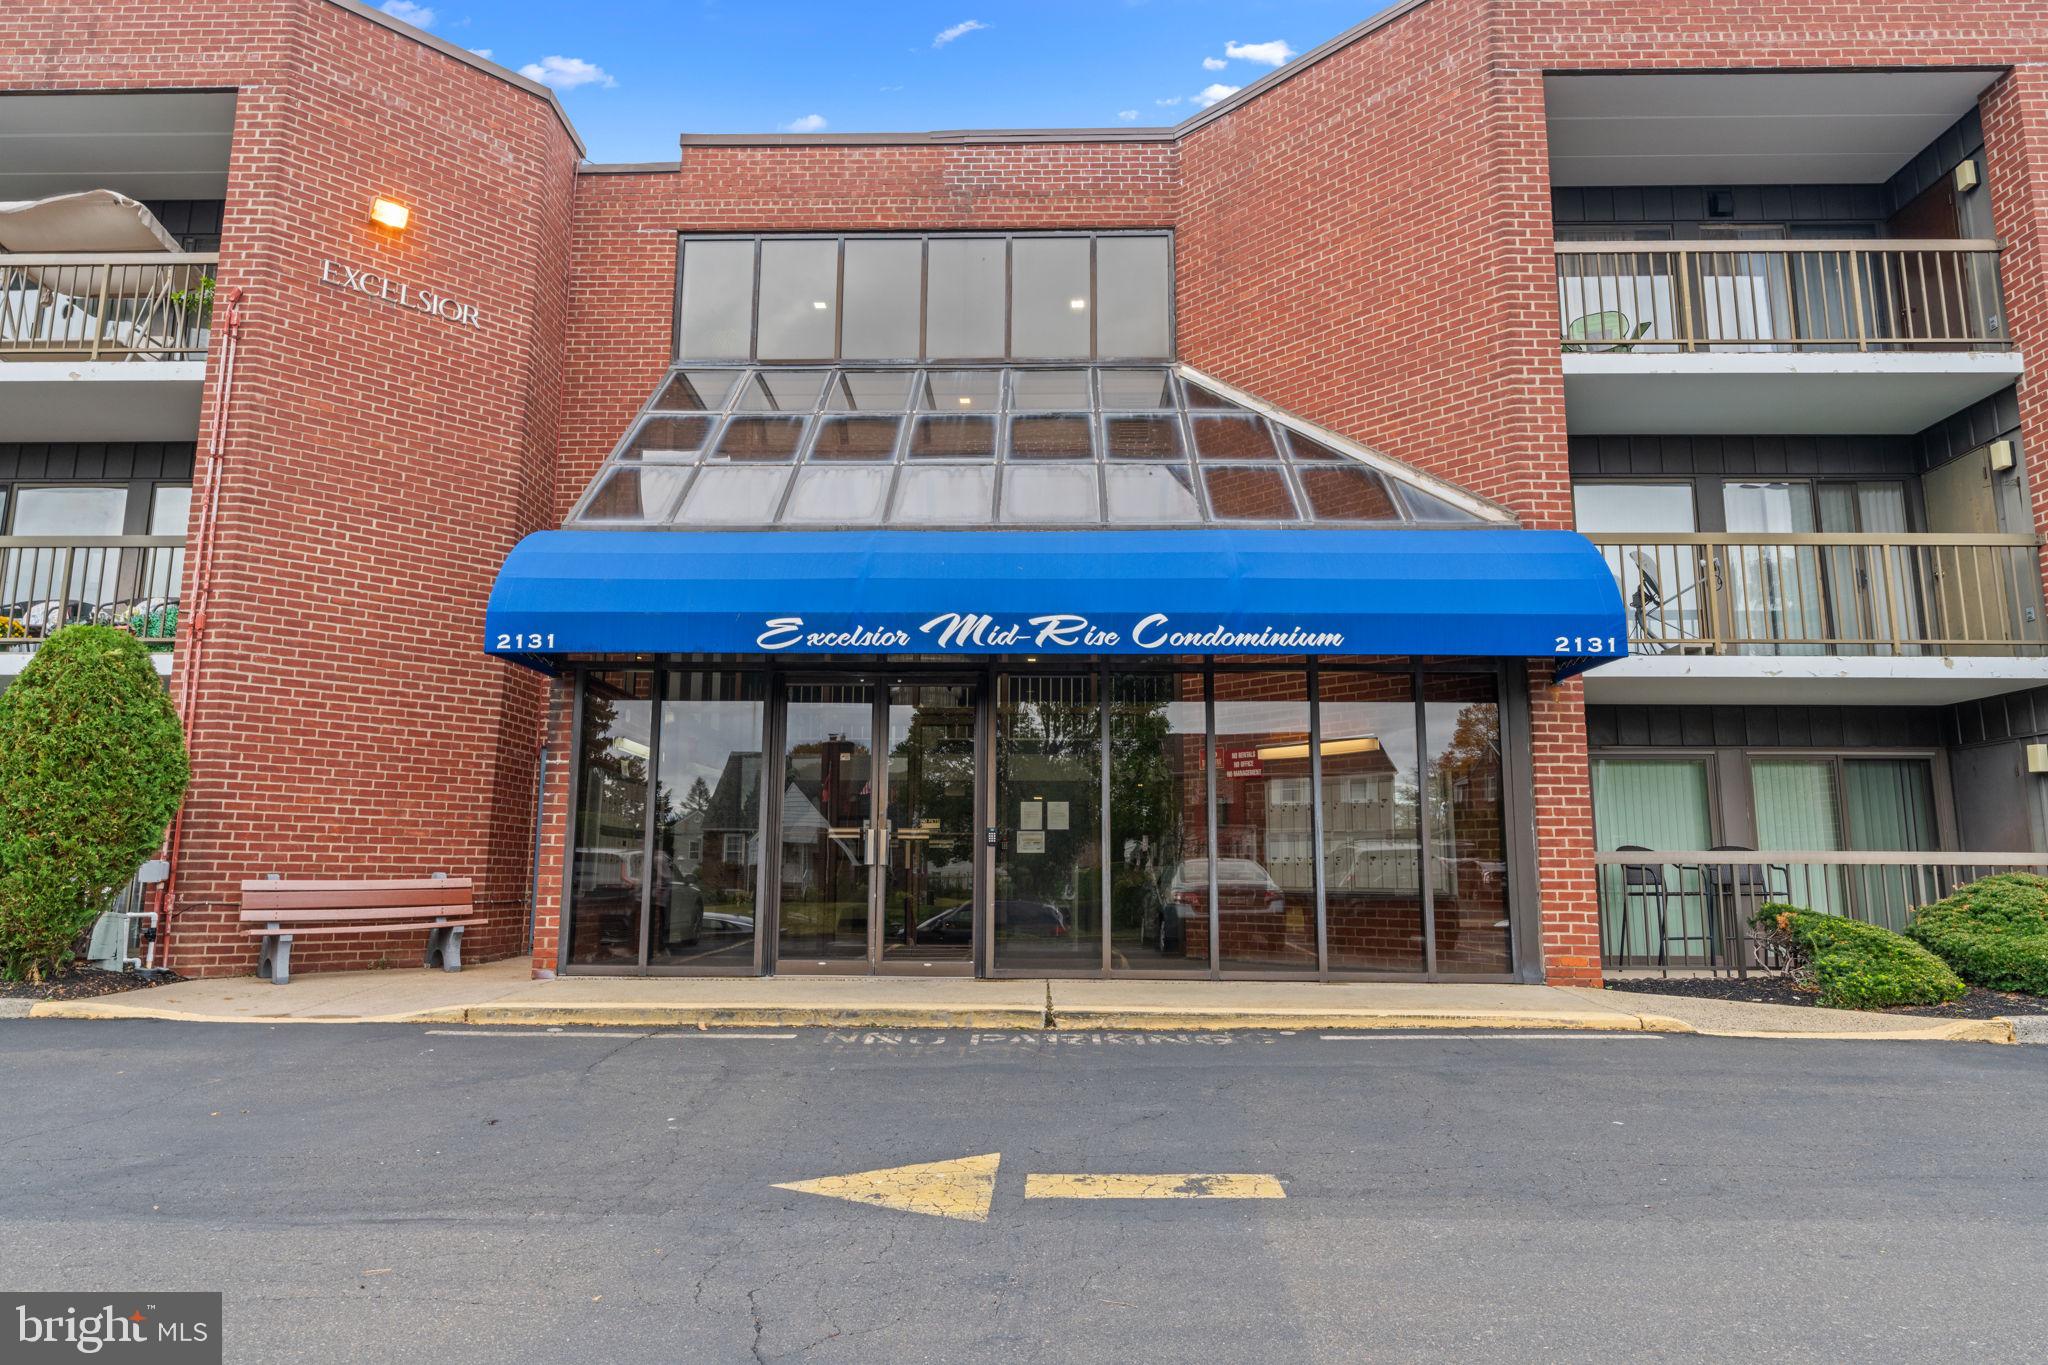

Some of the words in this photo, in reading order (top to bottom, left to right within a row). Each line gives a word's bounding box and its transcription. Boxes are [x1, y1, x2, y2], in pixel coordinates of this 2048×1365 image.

[321, 258, 481, 331] EXCELSIOR
[756, 616, 911, 650] Excelsior
[919, 612, 1120, 649] Mid-Rise
[1132, 612, 1345, 649] Condominium
[496, 633, 555, 649] 2131
[1554, 636, 1616, 653] 2131
[1238, 750, 1255, 759] RENTALS
[1233, 768, 1262, 777] MANAGEMENT
